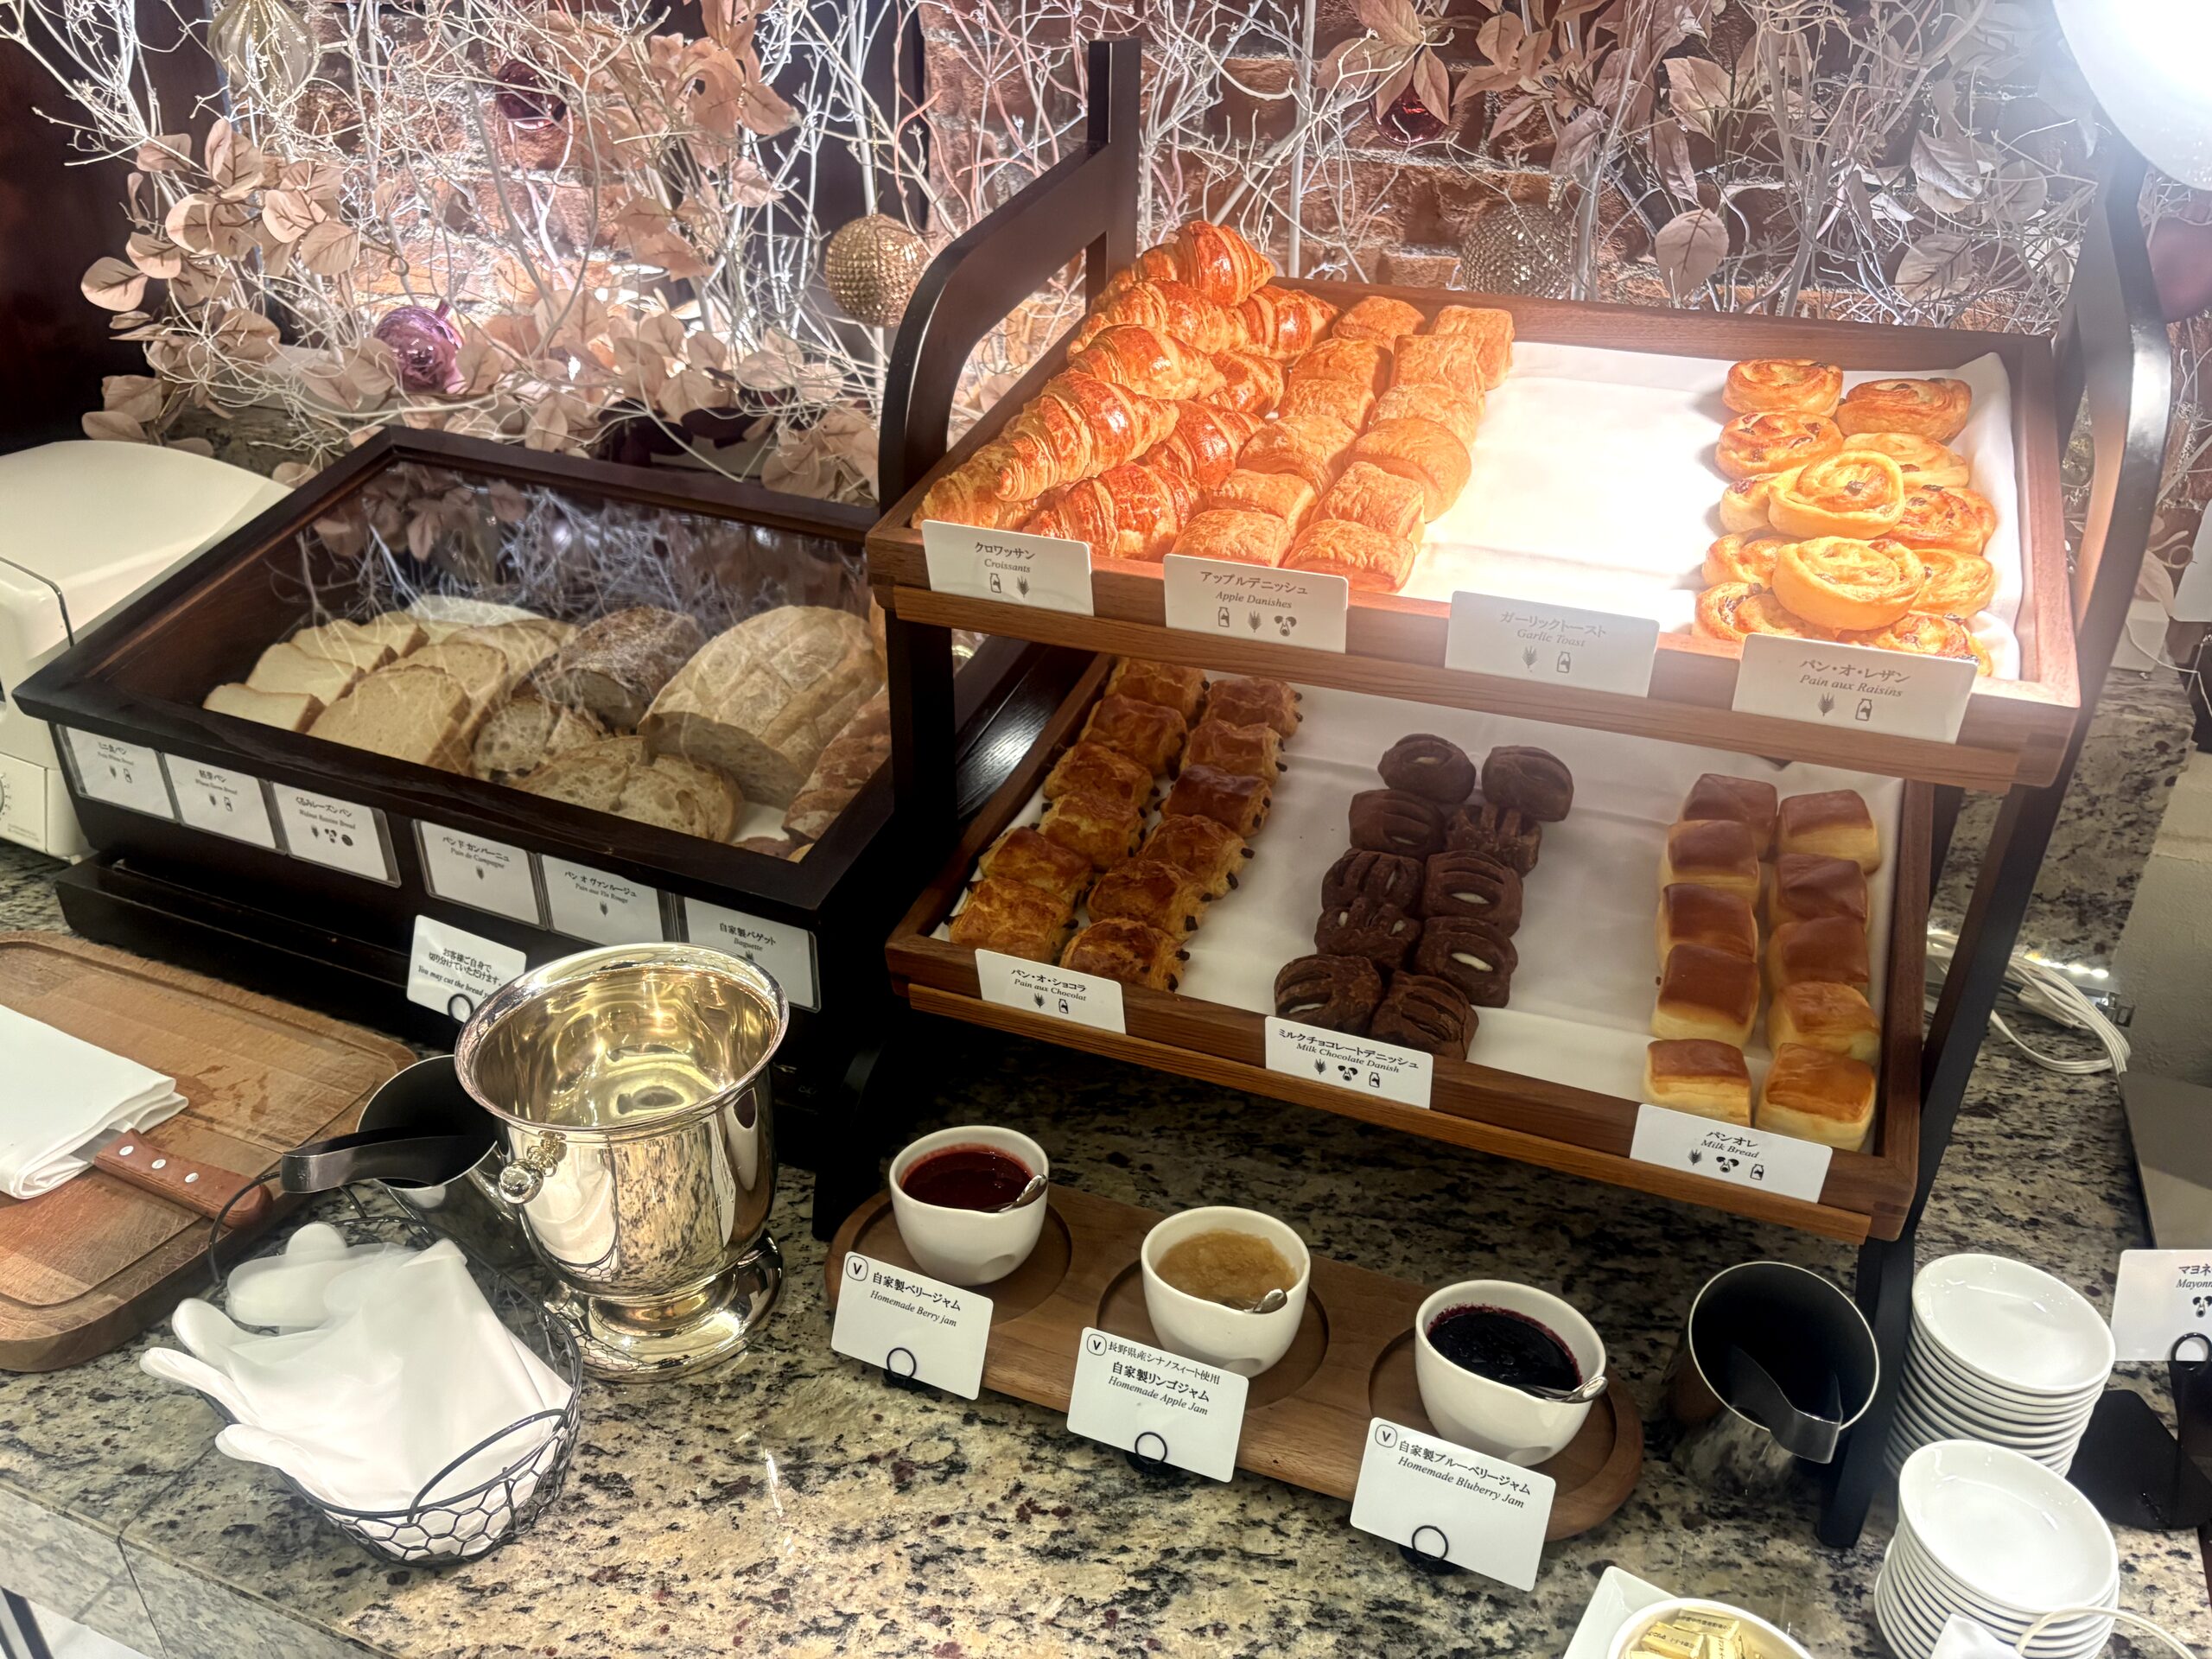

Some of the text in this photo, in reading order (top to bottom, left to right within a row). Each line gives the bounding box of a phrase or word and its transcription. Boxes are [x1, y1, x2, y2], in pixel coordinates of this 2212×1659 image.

[975, 542, 1036, 561] クロワッサン
[984, 558, 1031, 573] Croissants
[1200, 570, 1308, 595] アップルデニッシュ
[1215, 590, 1293, 609] Apple Danishes
[1500, 611, 1606, 638] ガーリックトースト
[1516, 628, 1586, 647] Garlic Toast
[1799, 659, 1911, 683] パン・オ・レザン
[1799, 674, 1904, 697] Pain aux Raisins
[719, 921, 777, 946] 自家製バゲット
[734, 938, 764, 952] Baguette
[442, 947, 493, 973] お客様ご自身で
[417, 964, 429, 976] You
[429, 970, 443, 983] may
[443, 975, 454, 986] cut
[454, 979, 466, 990] the
[465, 982, 484, 997] bread
[1011, 969, 1087, 993] パン・オ・ショコラ
[1014, 978, 1087, 1002] Pain aux Chocolat
[1278, 1028, 1420, 1070] ミルクチョコレートデニッシュ
[1296, 1042, 1400, 1073] Milk Chocolate Danish
[1700, 1139, 1759, 1158] Milk Bread
[871, 1271, 962, 1313] 自家製ベリージャム
[870, 1289, 958, 1328] Homemade Berry jam
[1111, 1360, 1211, 1403] 自家製リンゴジャム
[1108, 1376, 1209, 1416] Homemade Apple Jam
[1398, 1440, 1532, 1496] 自家製ブルーベリージャム
[1397, 1455, 1525, 1510] Homemade Bluberry Jam
